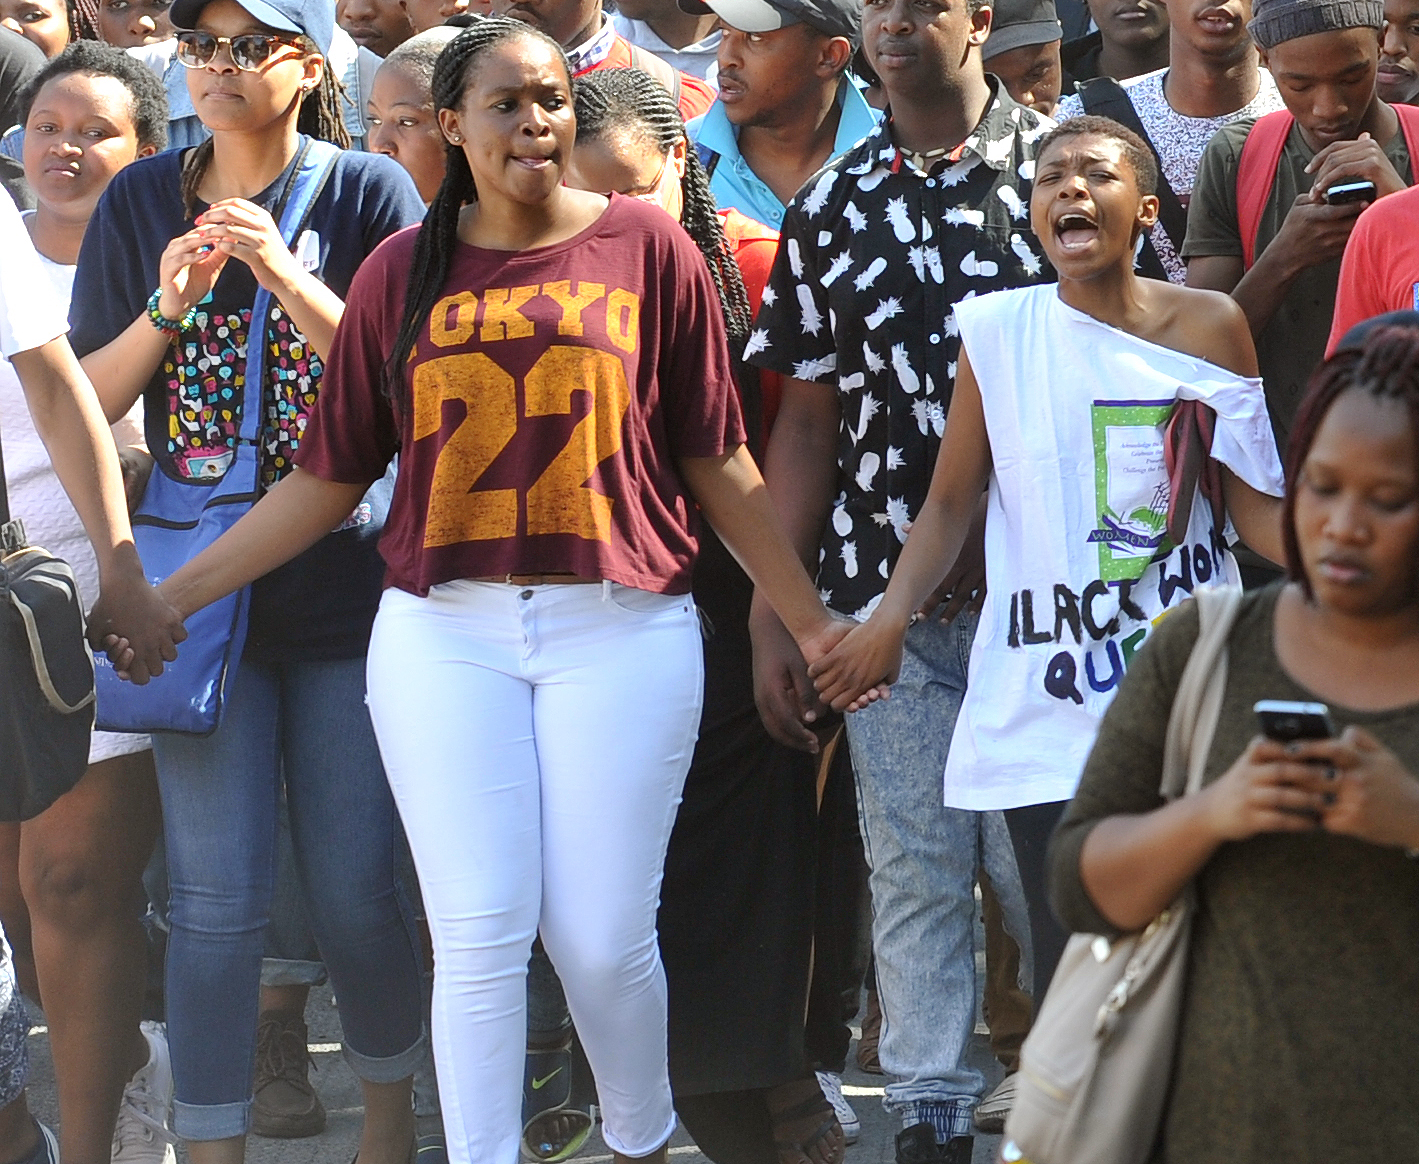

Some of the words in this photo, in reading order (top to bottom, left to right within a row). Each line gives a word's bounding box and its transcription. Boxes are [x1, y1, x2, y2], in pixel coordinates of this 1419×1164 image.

[406, 279, 640, 363] OKYO
[413, 344, 631, 549] 22
[1092, 530, 1150, 547] WOMEN
